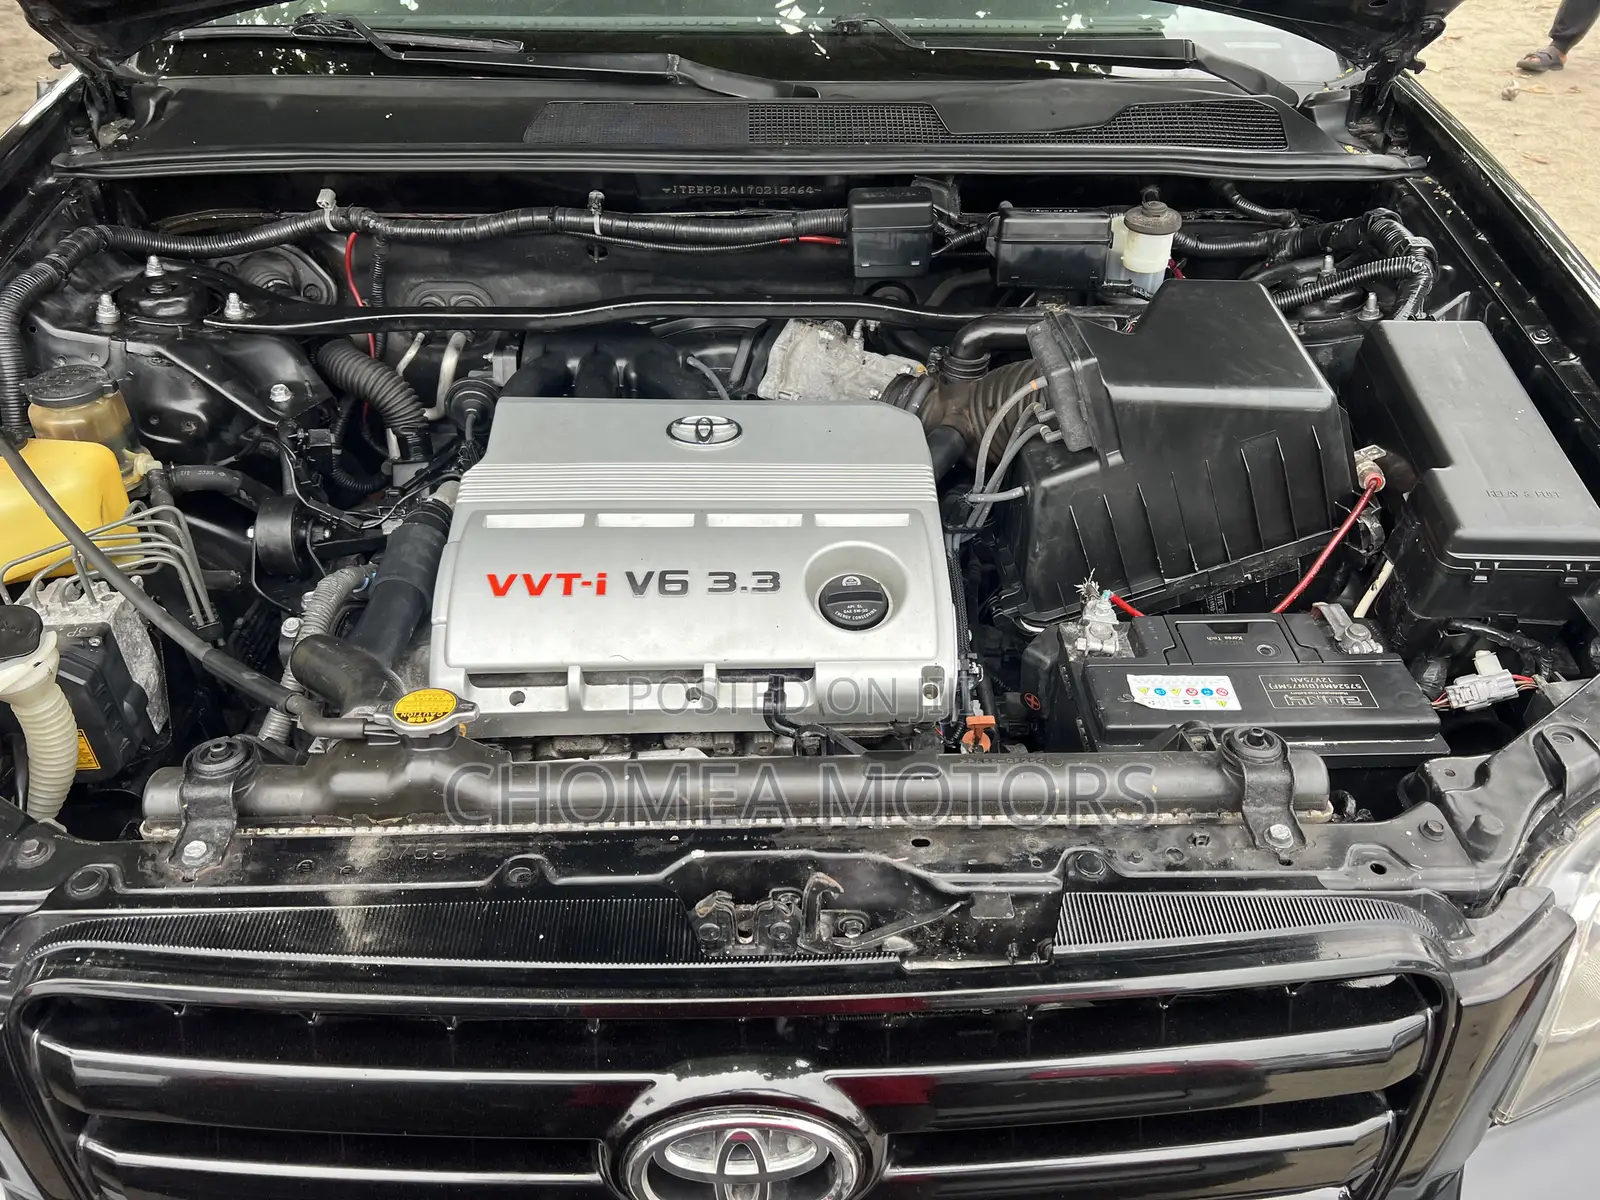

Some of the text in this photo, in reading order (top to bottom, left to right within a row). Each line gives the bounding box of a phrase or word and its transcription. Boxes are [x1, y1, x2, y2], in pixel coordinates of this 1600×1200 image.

[486, 570, 781, 597] VVT-i V6 3.3
